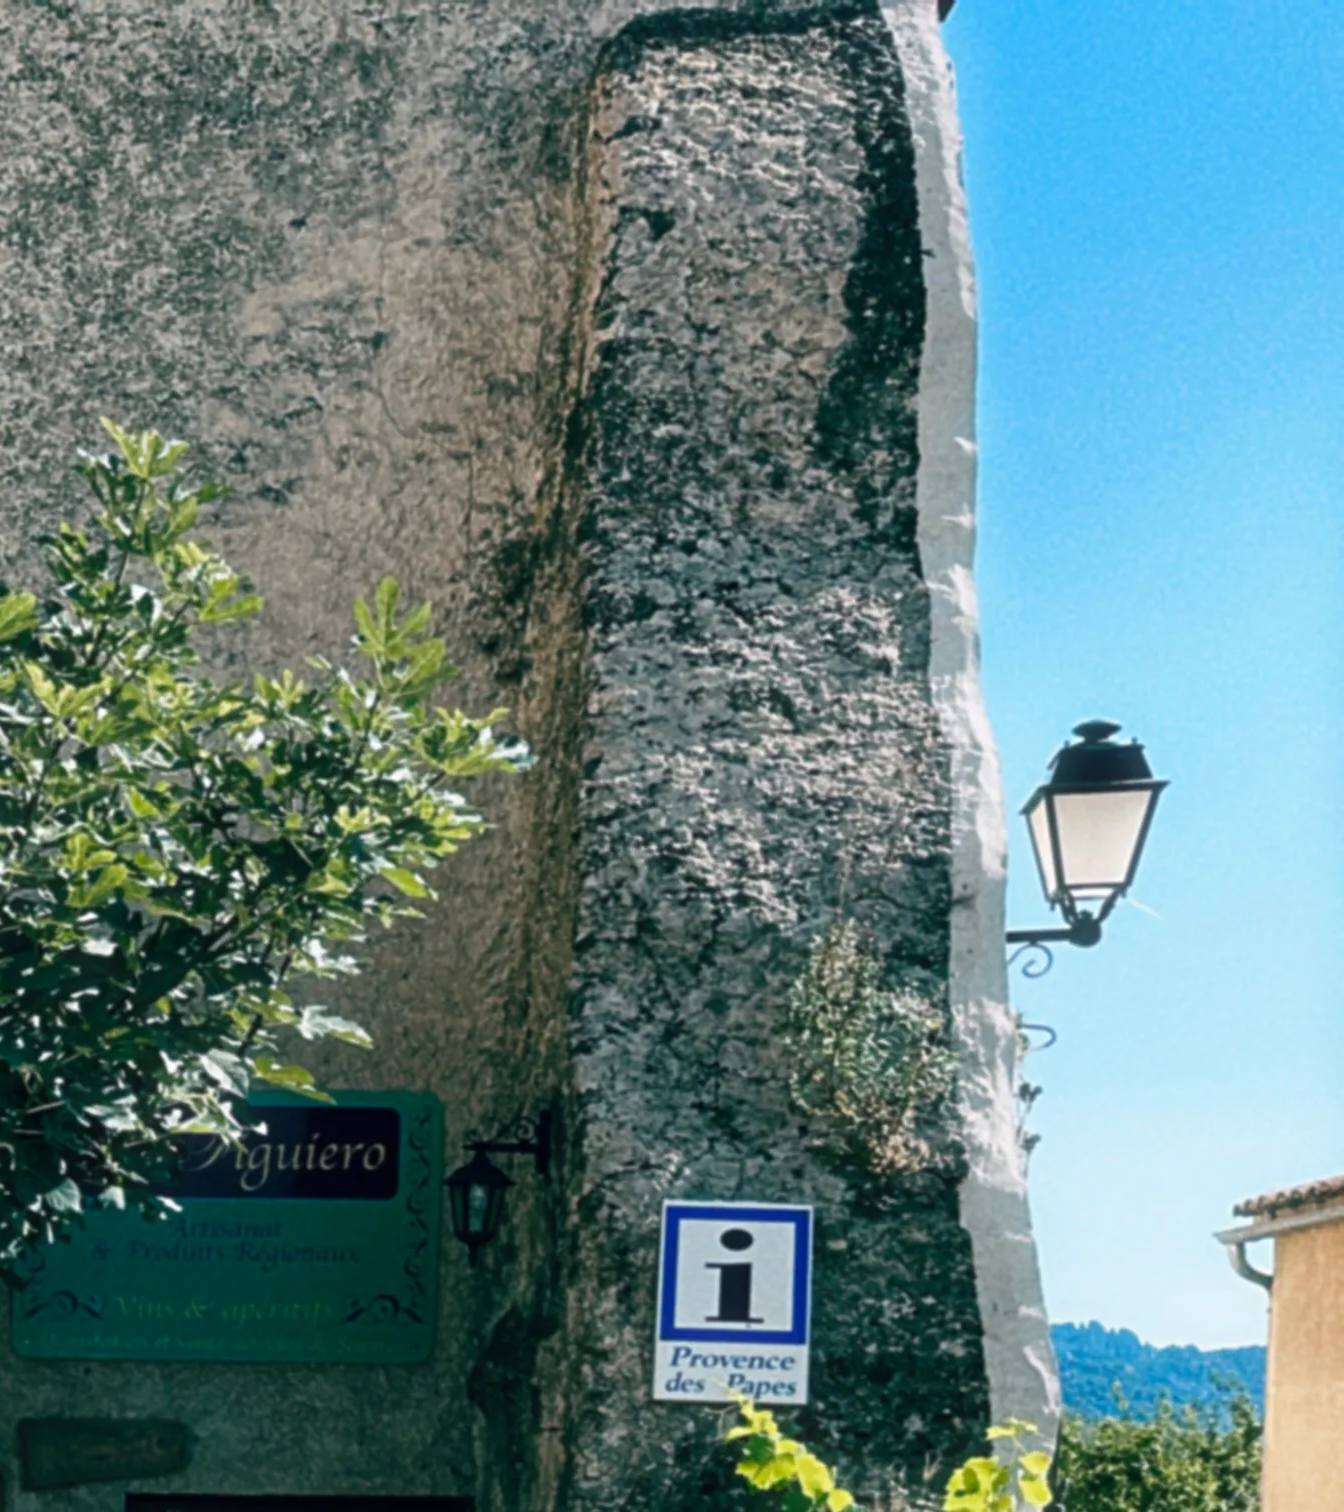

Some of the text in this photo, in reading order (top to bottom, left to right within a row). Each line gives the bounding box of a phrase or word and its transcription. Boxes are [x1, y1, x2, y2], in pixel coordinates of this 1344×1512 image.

[171, 1217, 283, 1239] Artisanat
[126, 1240, 226, 1262] Produits
[704, 1228, 765, 1324] i
[115, 1295, 175, 1320] Vins
[183, 1295, 217, 1320] &
[669, 1346, 797, 1372] Provence
[665, 1372, 798, 1400] des Papes
